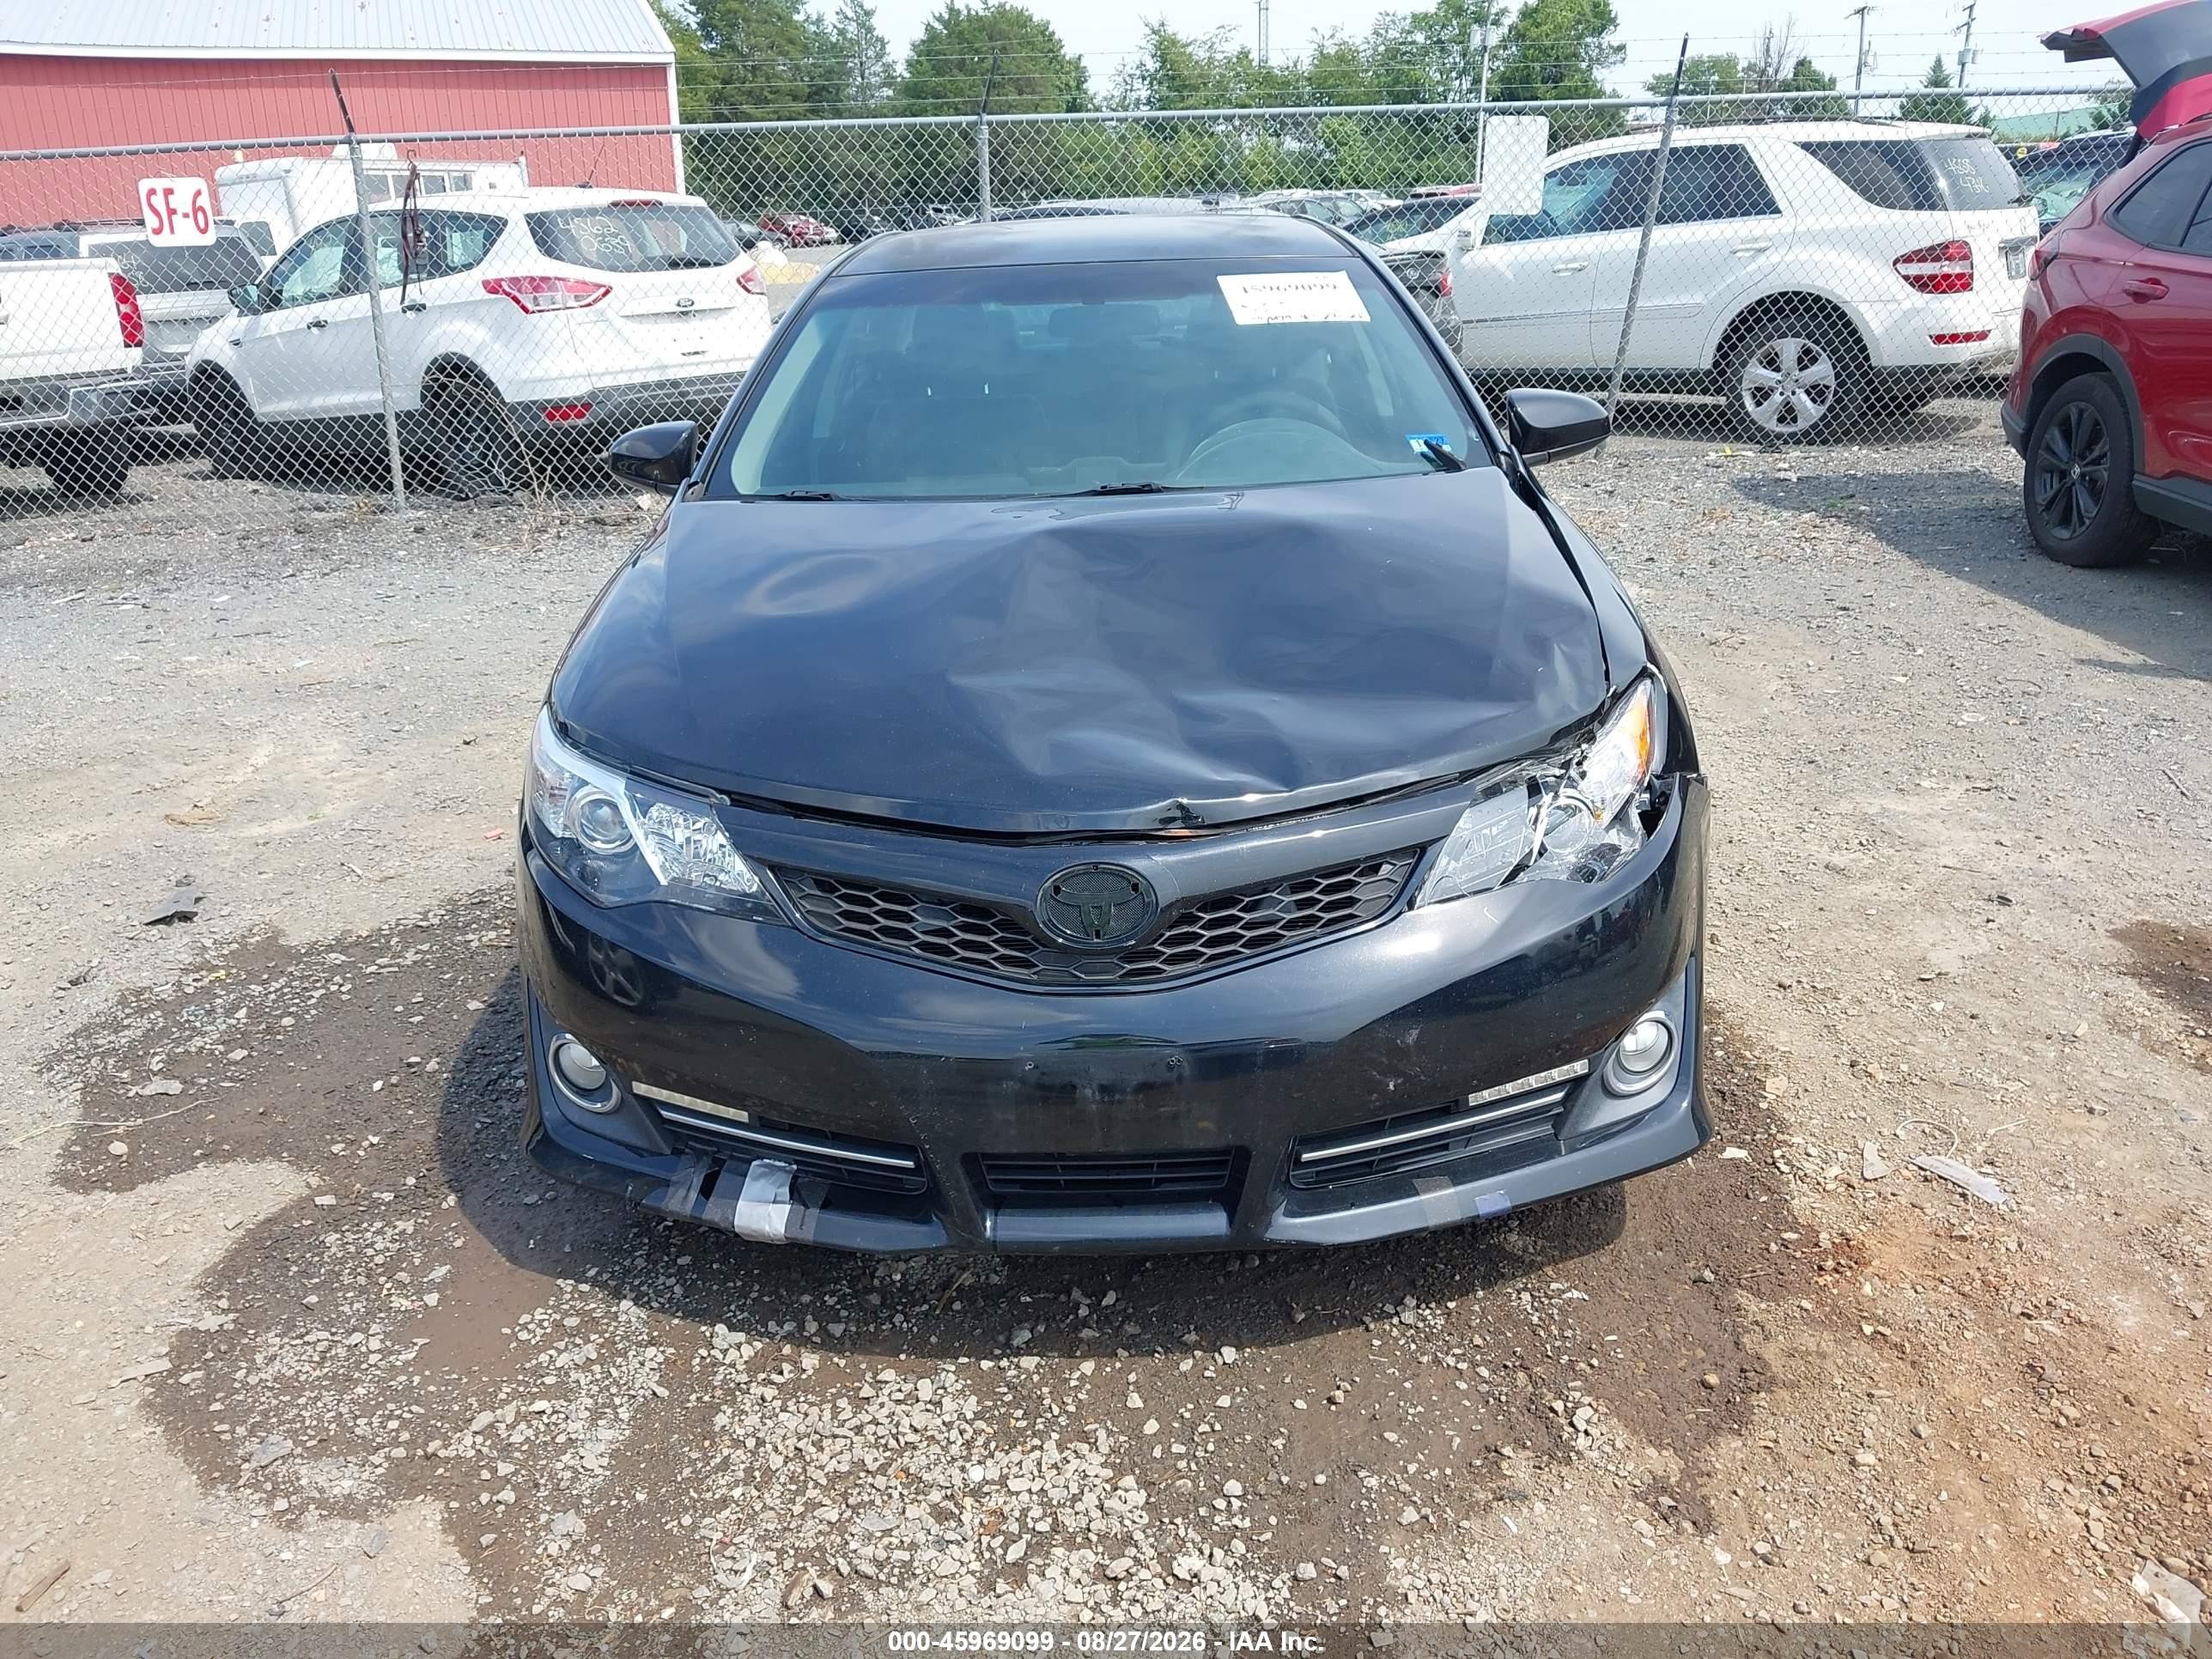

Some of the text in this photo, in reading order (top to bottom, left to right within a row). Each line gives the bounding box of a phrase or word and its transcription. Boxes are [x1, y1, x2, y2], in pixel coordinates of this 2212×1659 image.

[146, 187, 209, 235] SF-6
[556, 216, 618, 240] 4562
[580, 234, 632, 253] 0639
